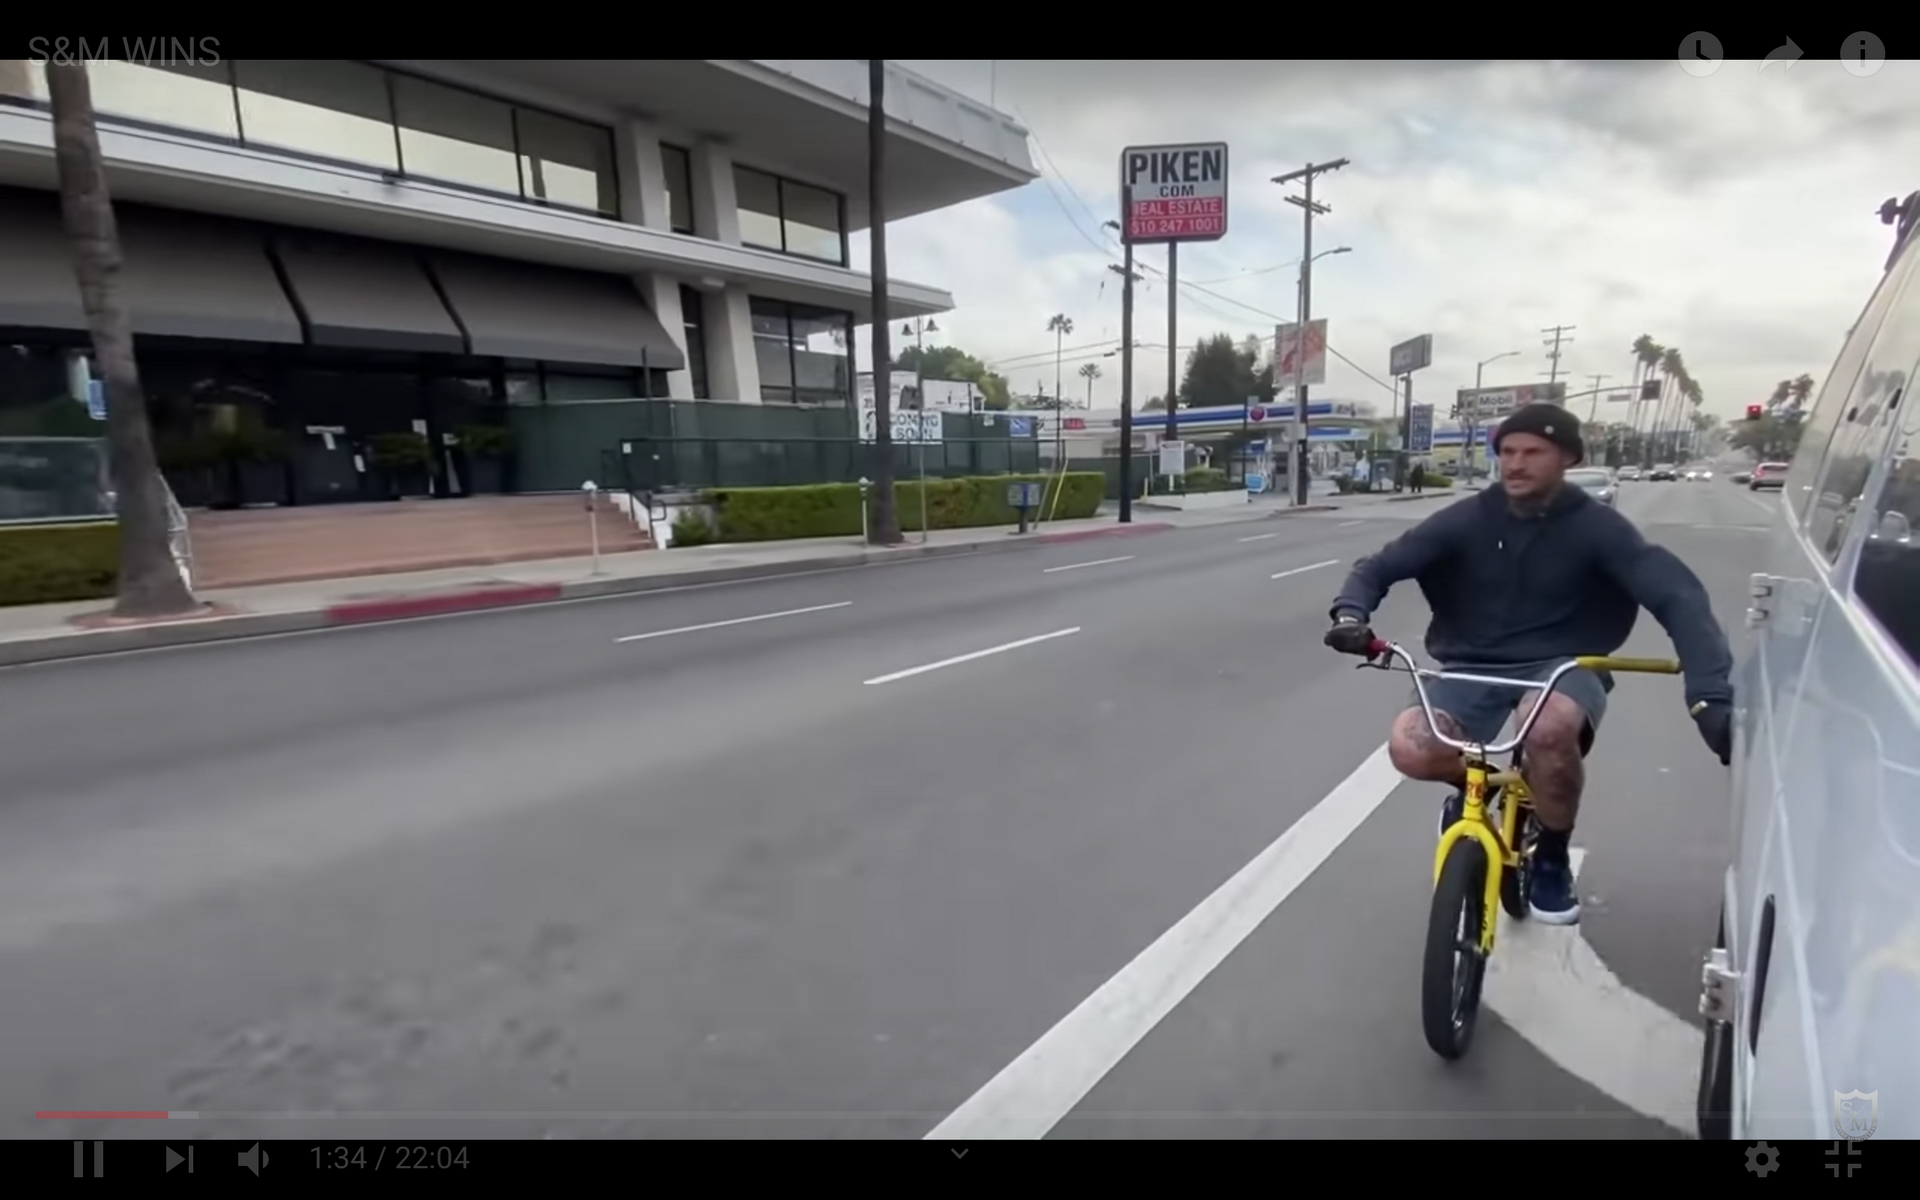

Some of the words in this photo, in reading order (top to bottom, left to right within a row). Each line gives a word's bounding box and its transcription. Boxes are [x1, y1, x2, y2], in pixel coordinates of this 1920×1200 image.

[1129, 151, 1221, 185] PIKEN
[1168, 200, 1219, 215] ESTATE
[1479, 394, 1514, 406] Mobil
[889, 412, 940, 428] COMNG
